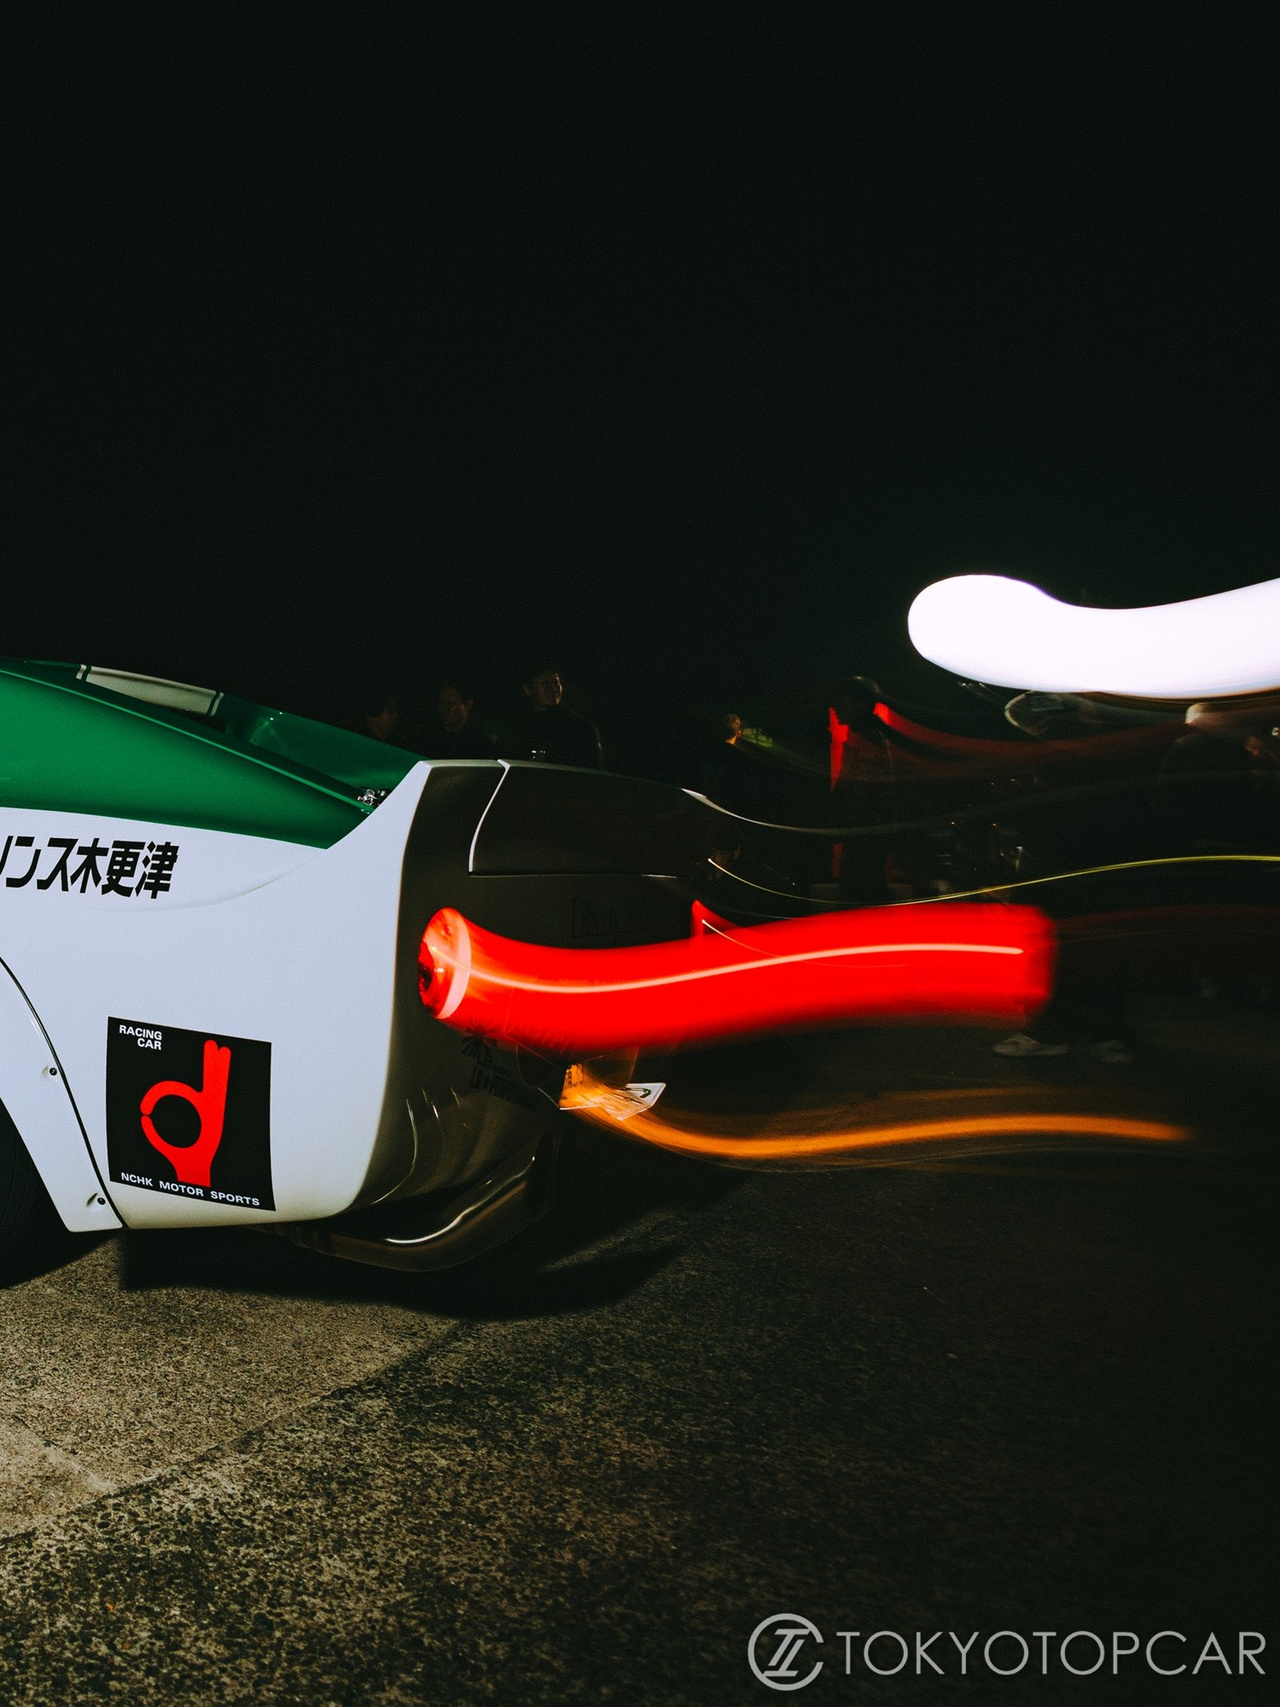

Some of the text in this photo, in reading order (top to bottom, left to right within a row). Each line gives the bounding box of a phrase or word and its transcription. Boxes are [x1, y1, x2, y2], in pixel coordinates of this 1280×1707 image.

[119, 1024, 162, 1041] RACING
[137, 1038, 162, 1050] CAR
[121, 1172, 260, 1206] NCHK MOTOR SPORTS
